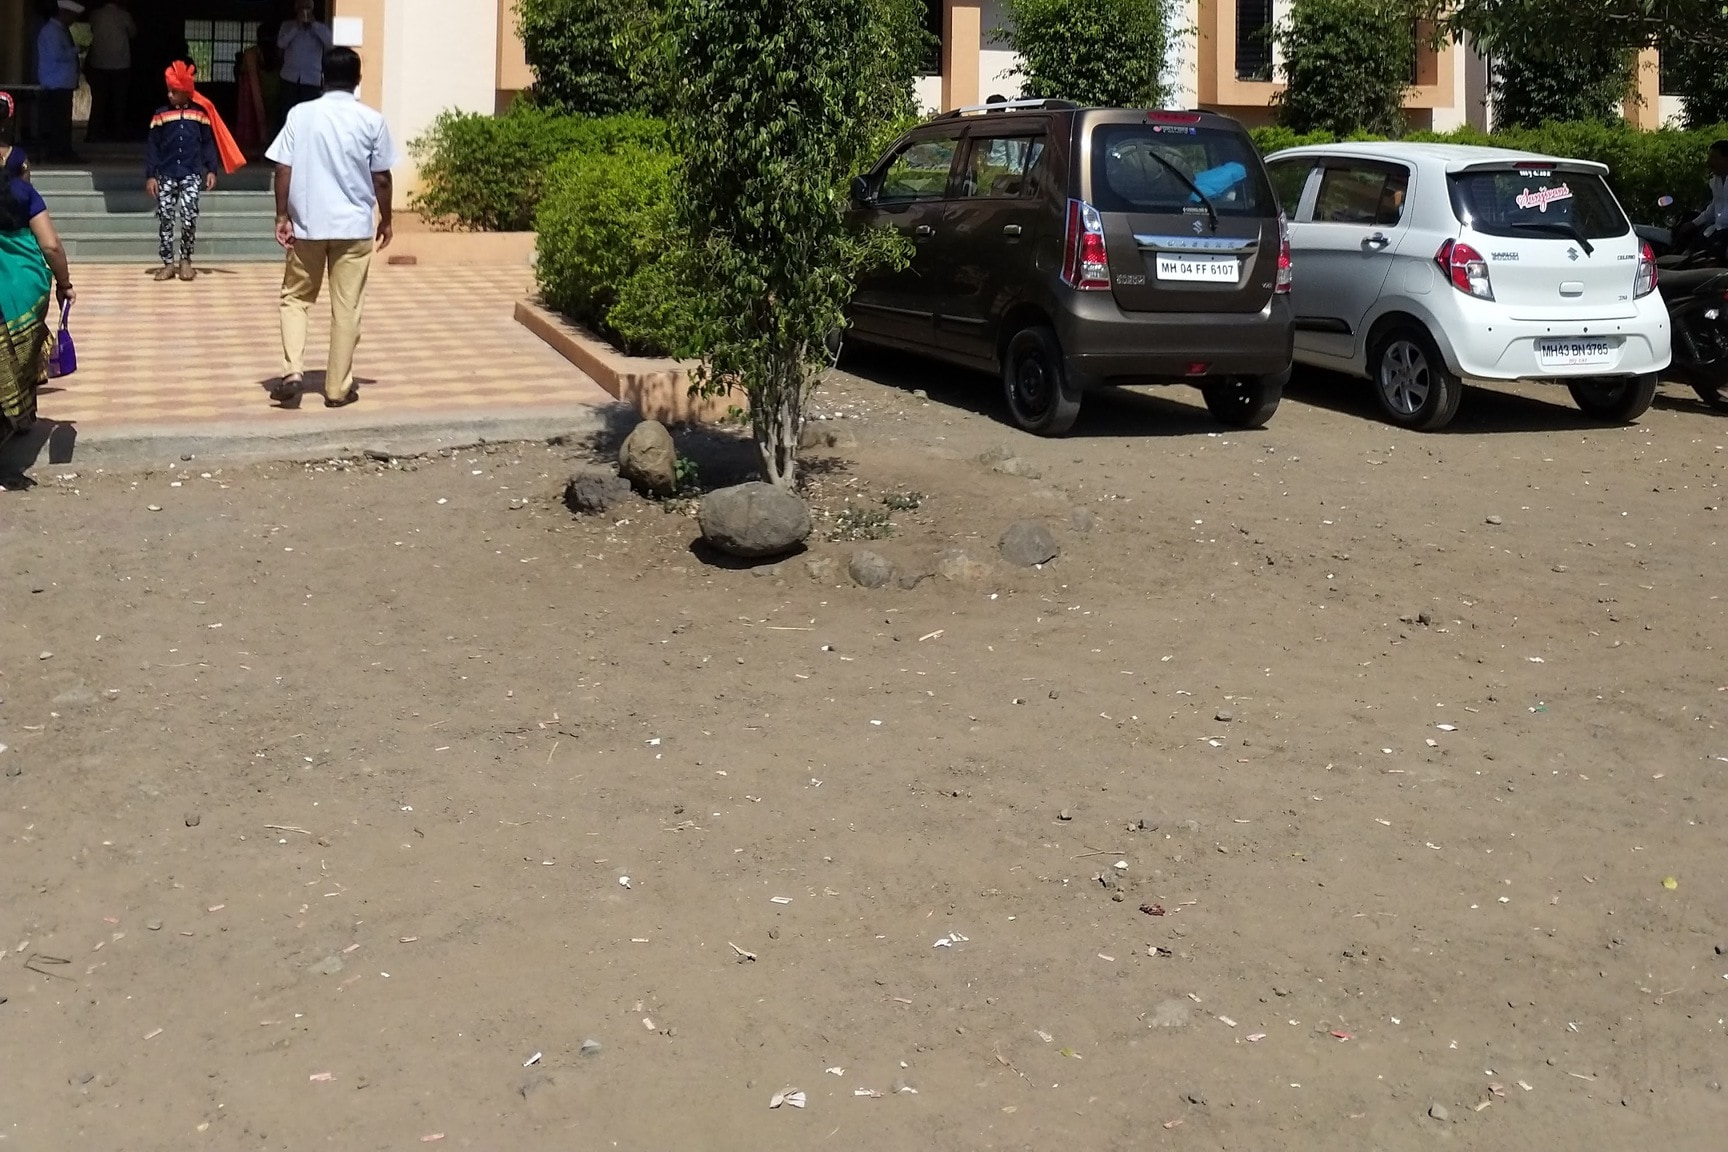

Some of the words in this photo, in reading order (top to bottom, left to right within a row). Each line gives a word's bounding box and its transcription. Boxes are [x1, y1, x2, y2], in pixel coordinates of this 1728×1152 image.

[1161, 262, 1177, 273] MH
[1180, 263, 1193, 273] 04
[1196, 264, 1207, 274] FF
[1210, 264, 1234, 275] 6107
